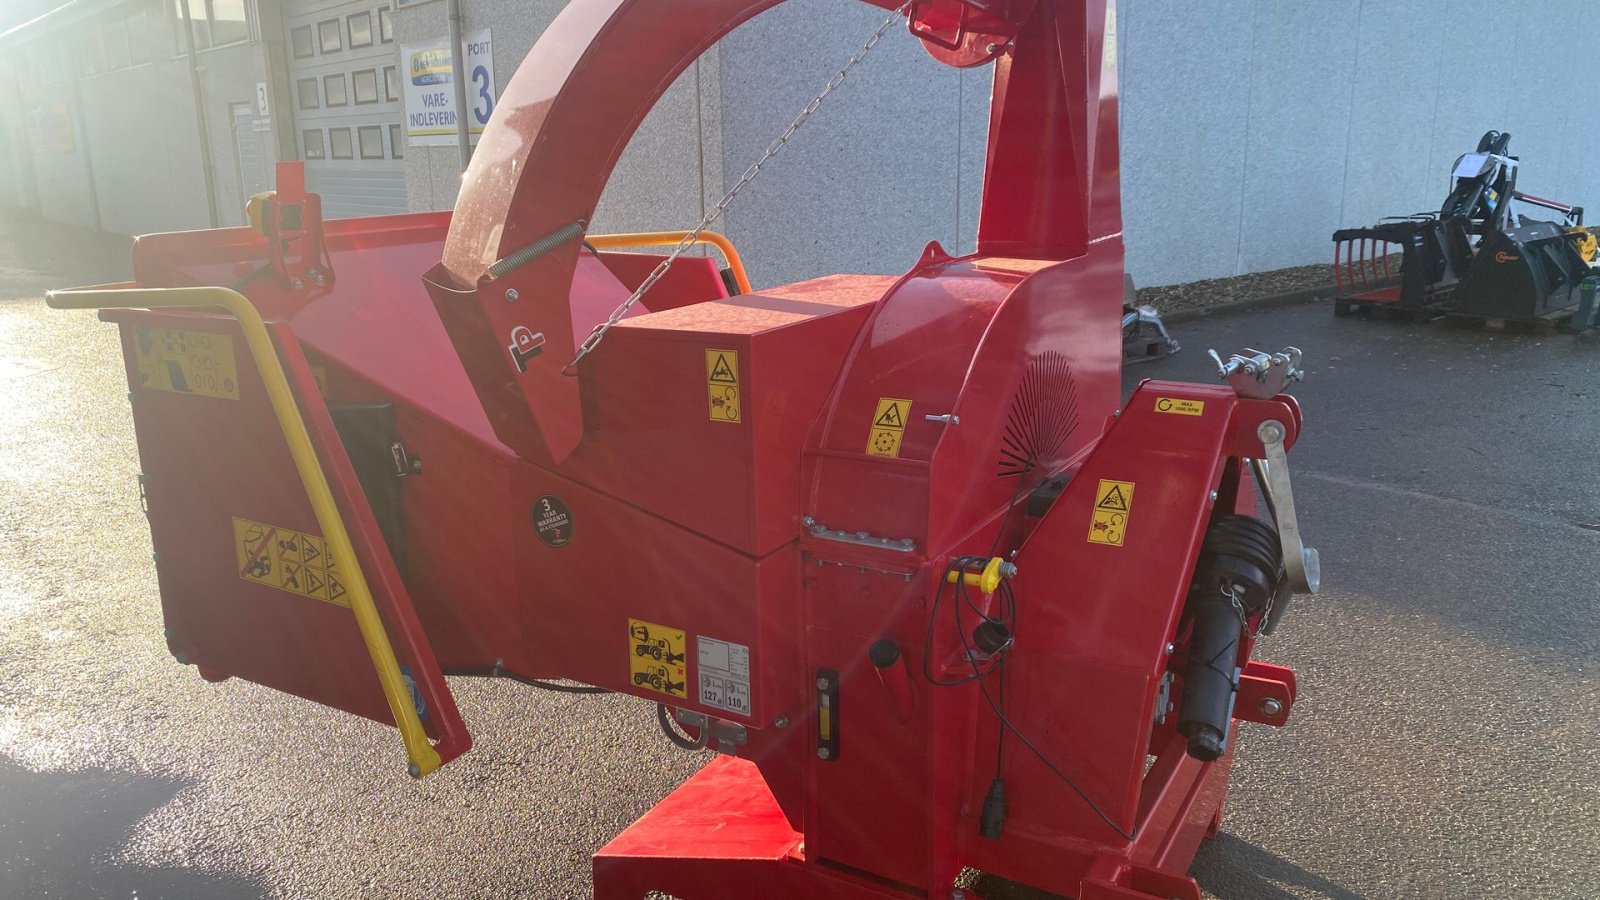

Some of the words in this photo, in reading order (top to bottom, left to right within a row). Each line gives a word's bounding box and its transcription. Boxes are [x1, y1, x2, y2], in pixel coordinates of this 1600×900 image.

[468, 41, 490, 56] PORT
[259, 87, 266, 111] 3
[422, 92, 449, 108] VARE-
[472, 65, 493, 125] 3
[542, 498, 551, 512] 3
[536, 512, 567, 528] WARRANTY
[542, 509, 558, 519] YEAR
[703, 689, 717, 702] 127
[728, 696, 742, 708] 110
